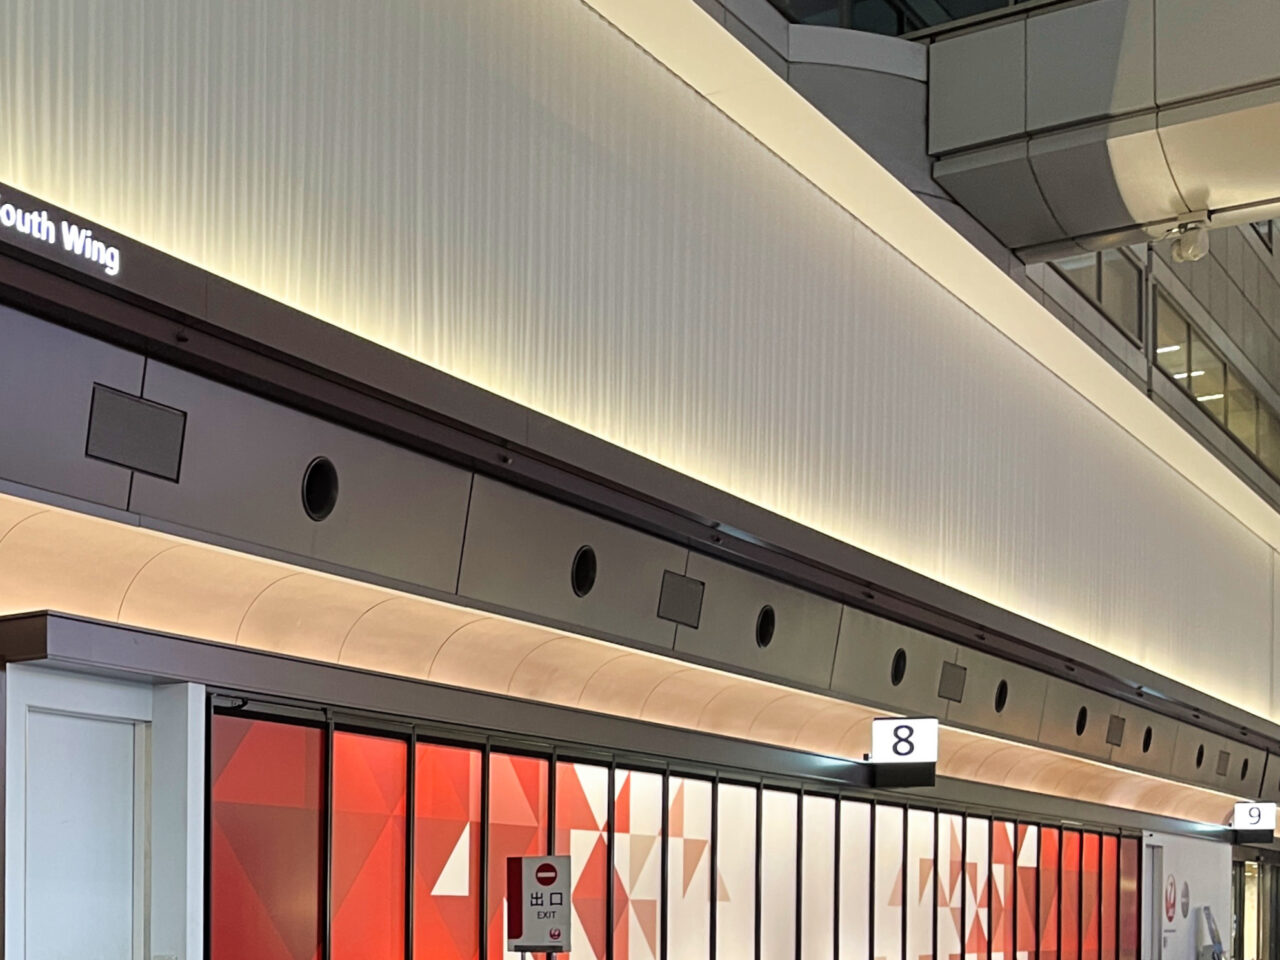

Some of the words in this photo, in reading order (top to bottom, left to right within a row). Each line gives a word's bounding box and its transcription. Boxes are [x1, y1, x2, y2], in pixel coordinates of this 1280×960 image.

[61, 220, 120, 276] Wing
[891, 725, 916, 757] 8
[1246, 806, 1262, 826] 9
[530, 891, 563, 907] 出口
[536, 910, 557, 920] EXIT
